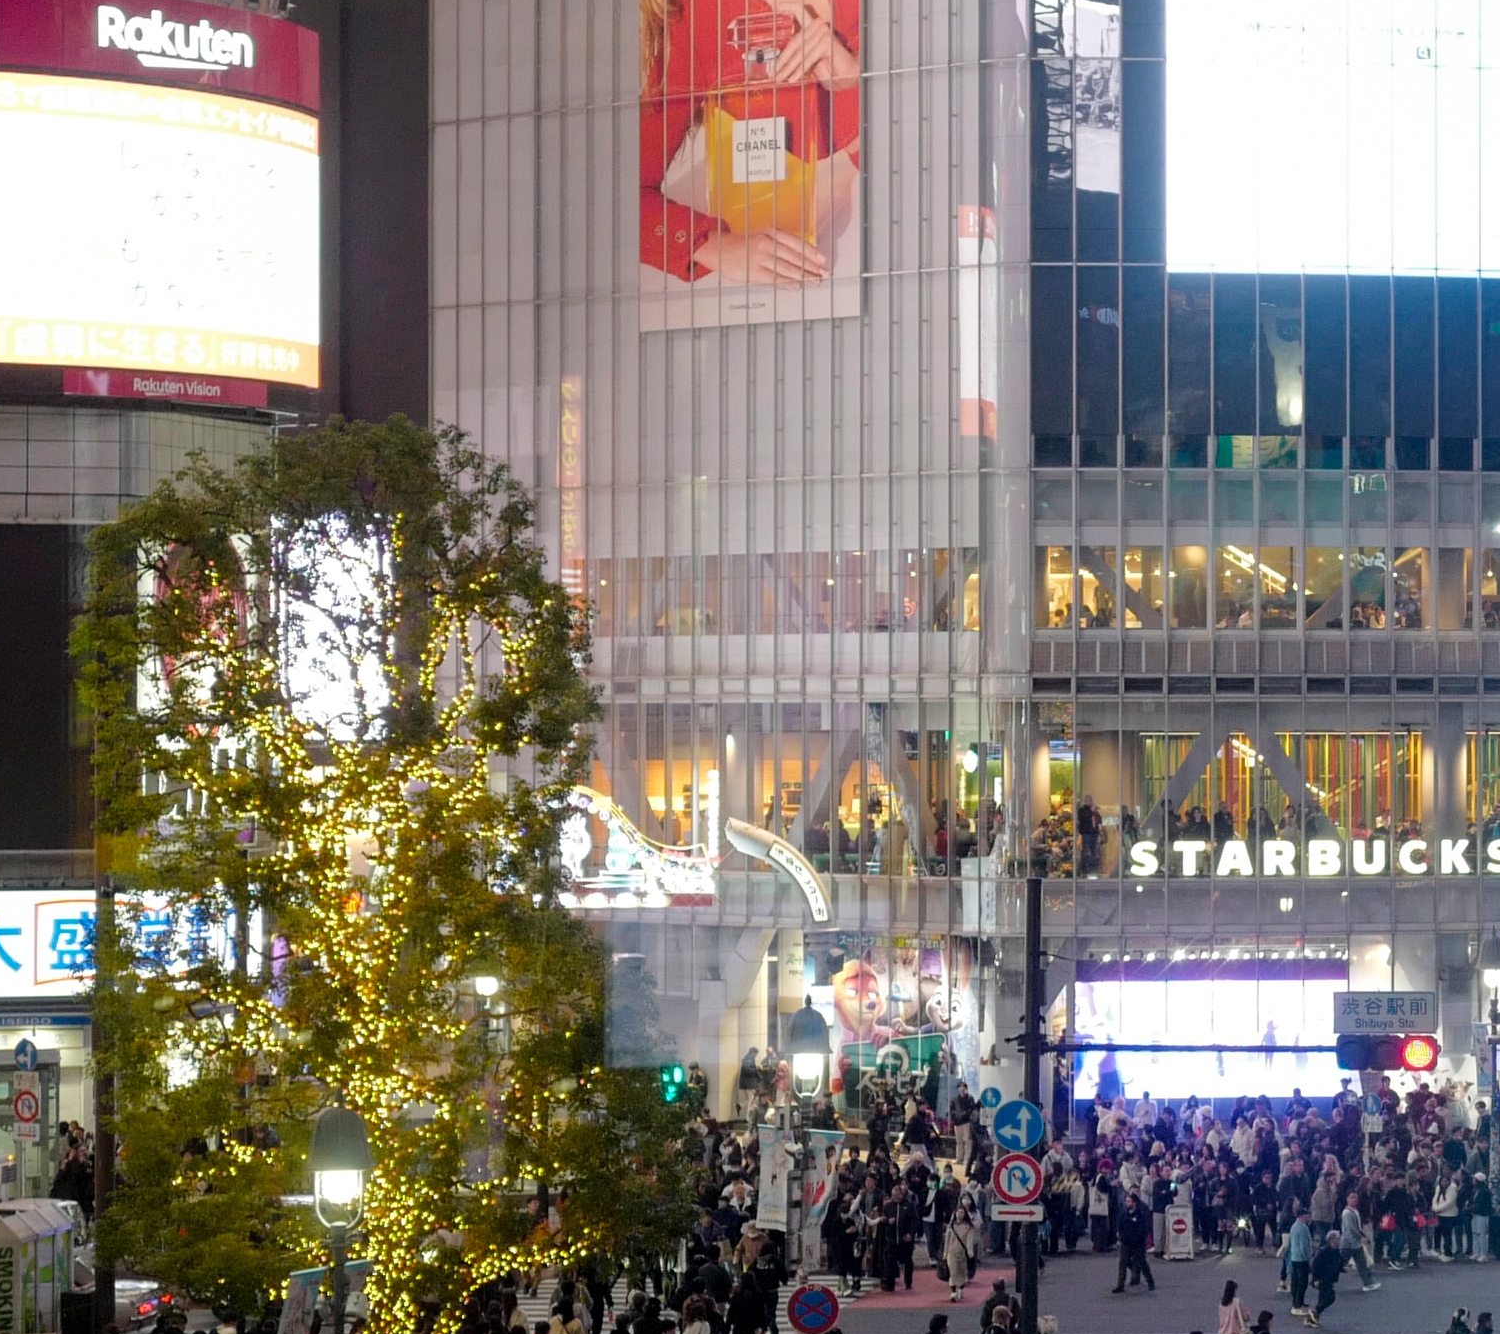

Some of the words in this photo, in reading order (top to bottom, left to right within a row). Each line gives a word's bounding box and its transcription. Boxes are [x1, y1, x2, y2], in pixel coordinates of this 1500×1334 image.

[97, 5, 253, 69] Rakuten
[735, 138, 782, 153] CHANEL
[133, 378, 184, 395] Rakuten
[186, 381, 220, 397] Vision
[1341, 996, 1428, 1016] 渋谷駅前
[1354, 1018, 1395, 1031] Shibuya
[1397, 1018, 1419, 1029] Sta.
